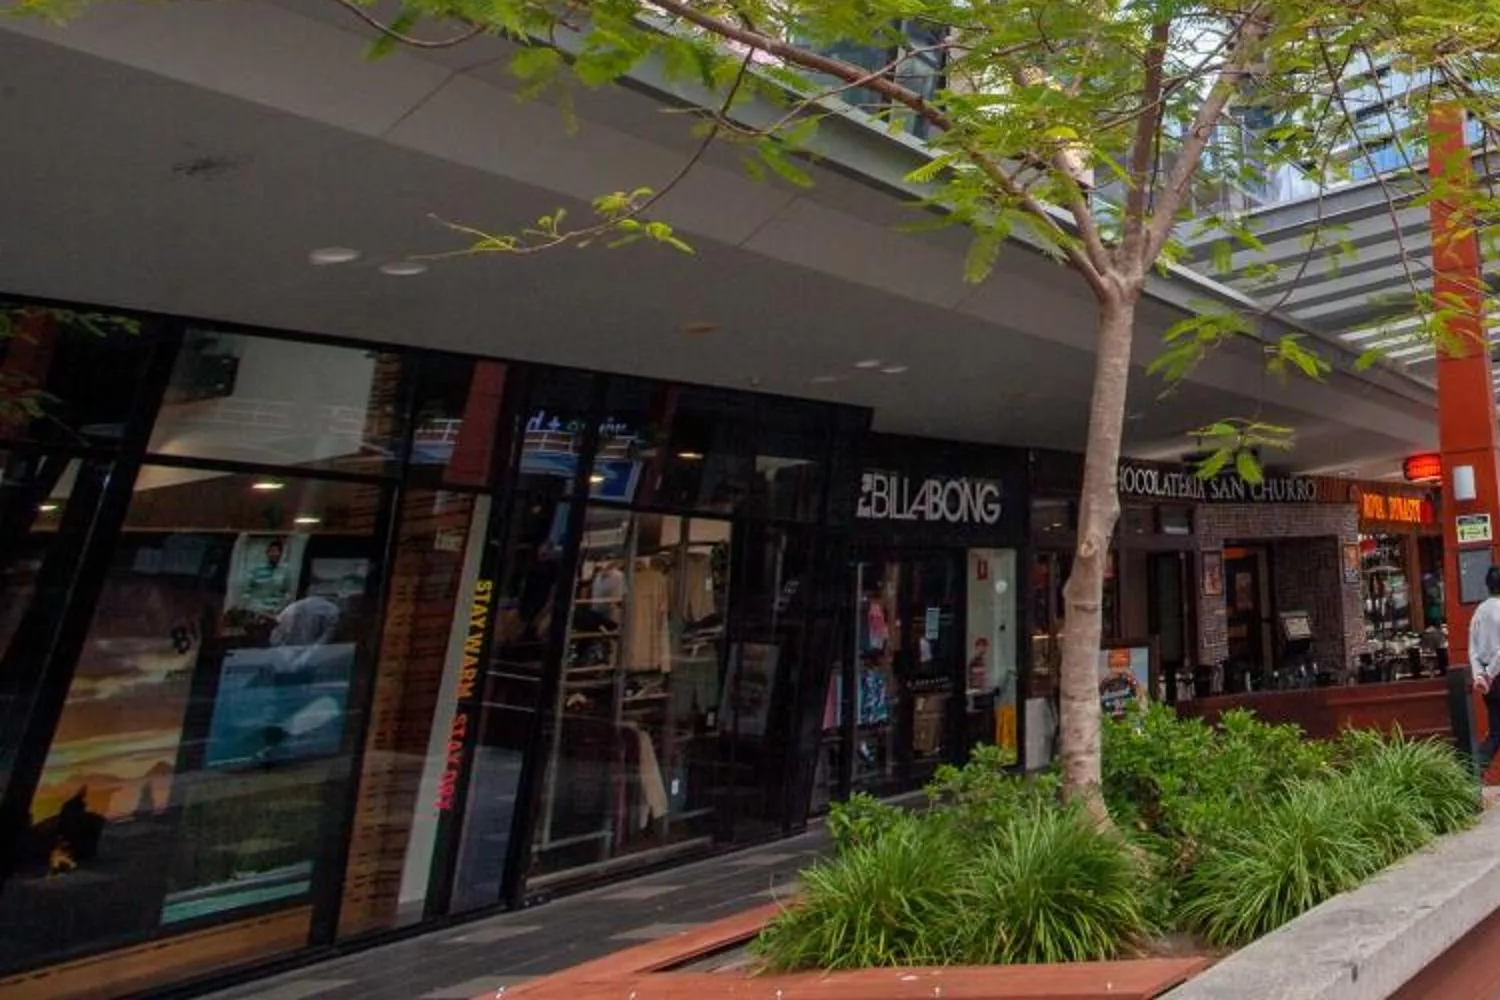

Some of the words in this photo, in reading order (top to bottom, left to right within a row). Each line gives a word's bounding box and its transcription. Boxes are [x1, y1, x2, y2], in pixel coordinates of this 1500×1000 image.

[871, 473, 1001, 524] BILLABONG
[1210, 476, 1246, 501] SAN
[1251, 478, 1317, 501] CHURRO
[470, 579, 493, 629] STAY
[456, 632, 484, 698] WARM
[446, 713, 468, 763] STAY
